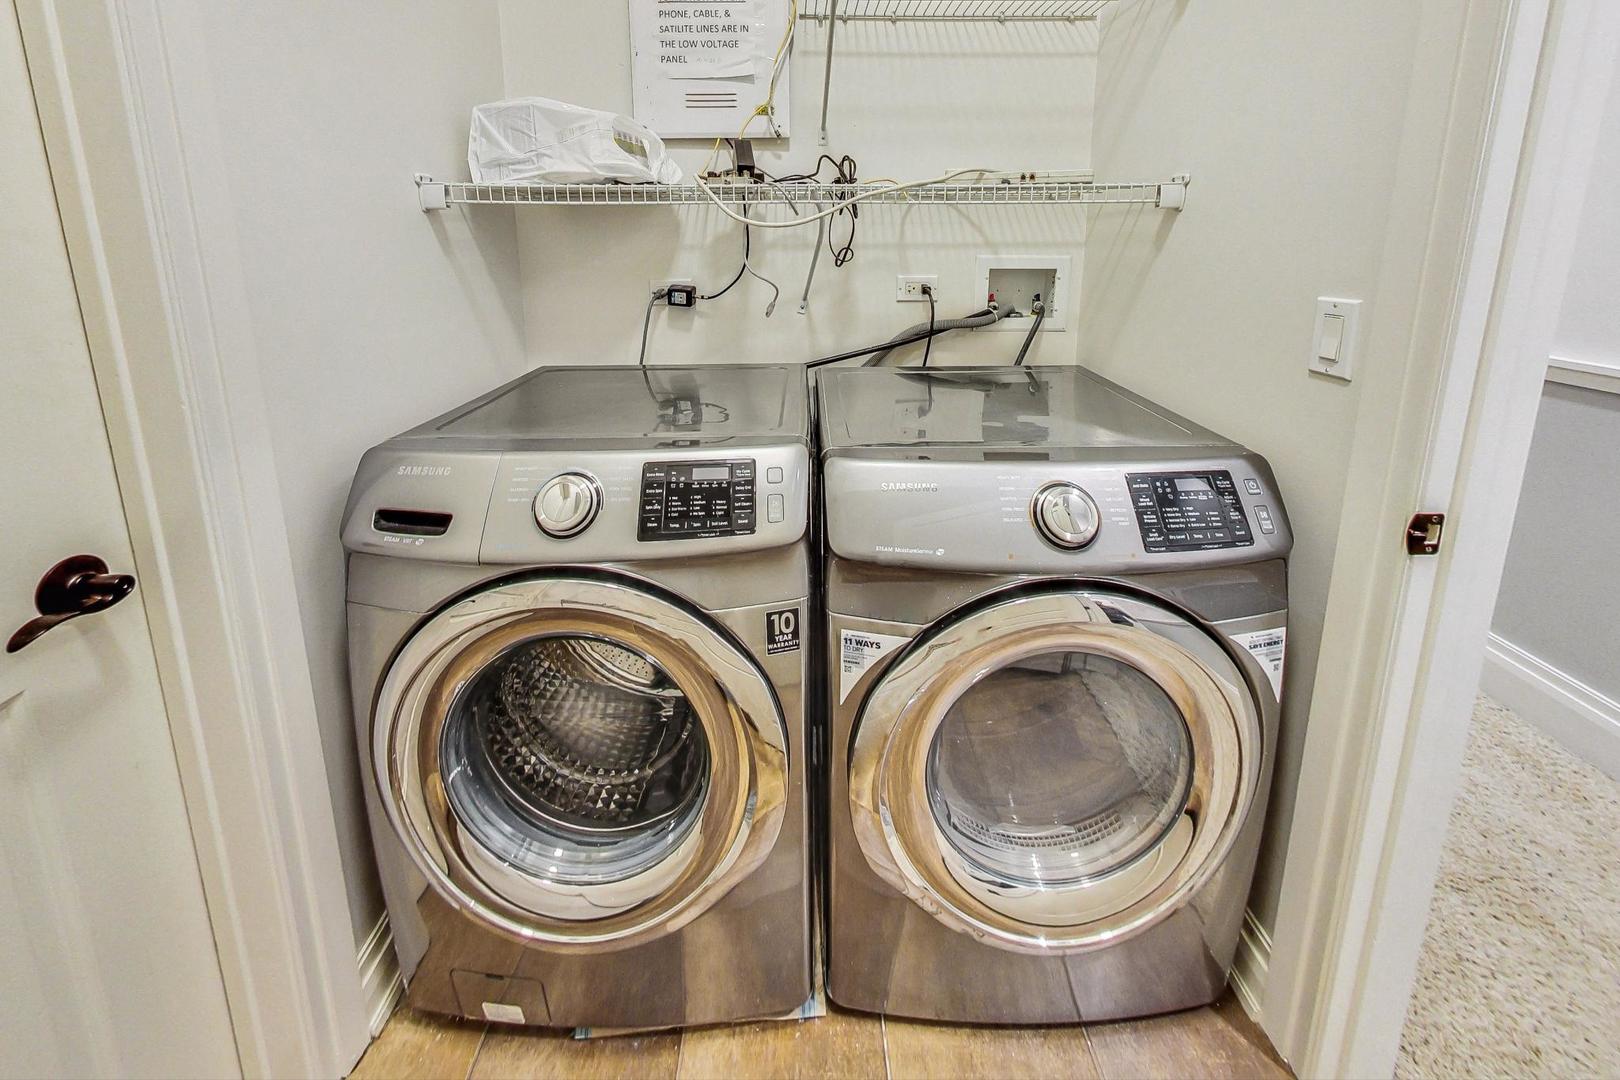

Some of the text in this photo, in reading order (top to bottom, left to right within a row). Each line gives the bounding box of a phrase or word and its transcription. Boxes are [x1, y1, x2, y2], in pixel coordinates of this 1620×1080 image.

[659, 10, 731, 19] PHONE, CABLE, &
[659, 25, 694, 33] SATILITE
[696, 25, 719, 33] LINES
[721, 25, 738, 33] ARE
[660, 40, 740, 48] THE LOW VOLTAGE
[660, 55, 688, 63] PANEL
[397, 465, 452, 476] SAMSUNG
[880, 481, 938, 493] SAMSUNG
[770, 612, 795, 635] 10
[775, 633, 793, 642] YEAR
[768, 640, 800, 650] WARRANTY
[843, 637, 881, 650] 11 WAYS
